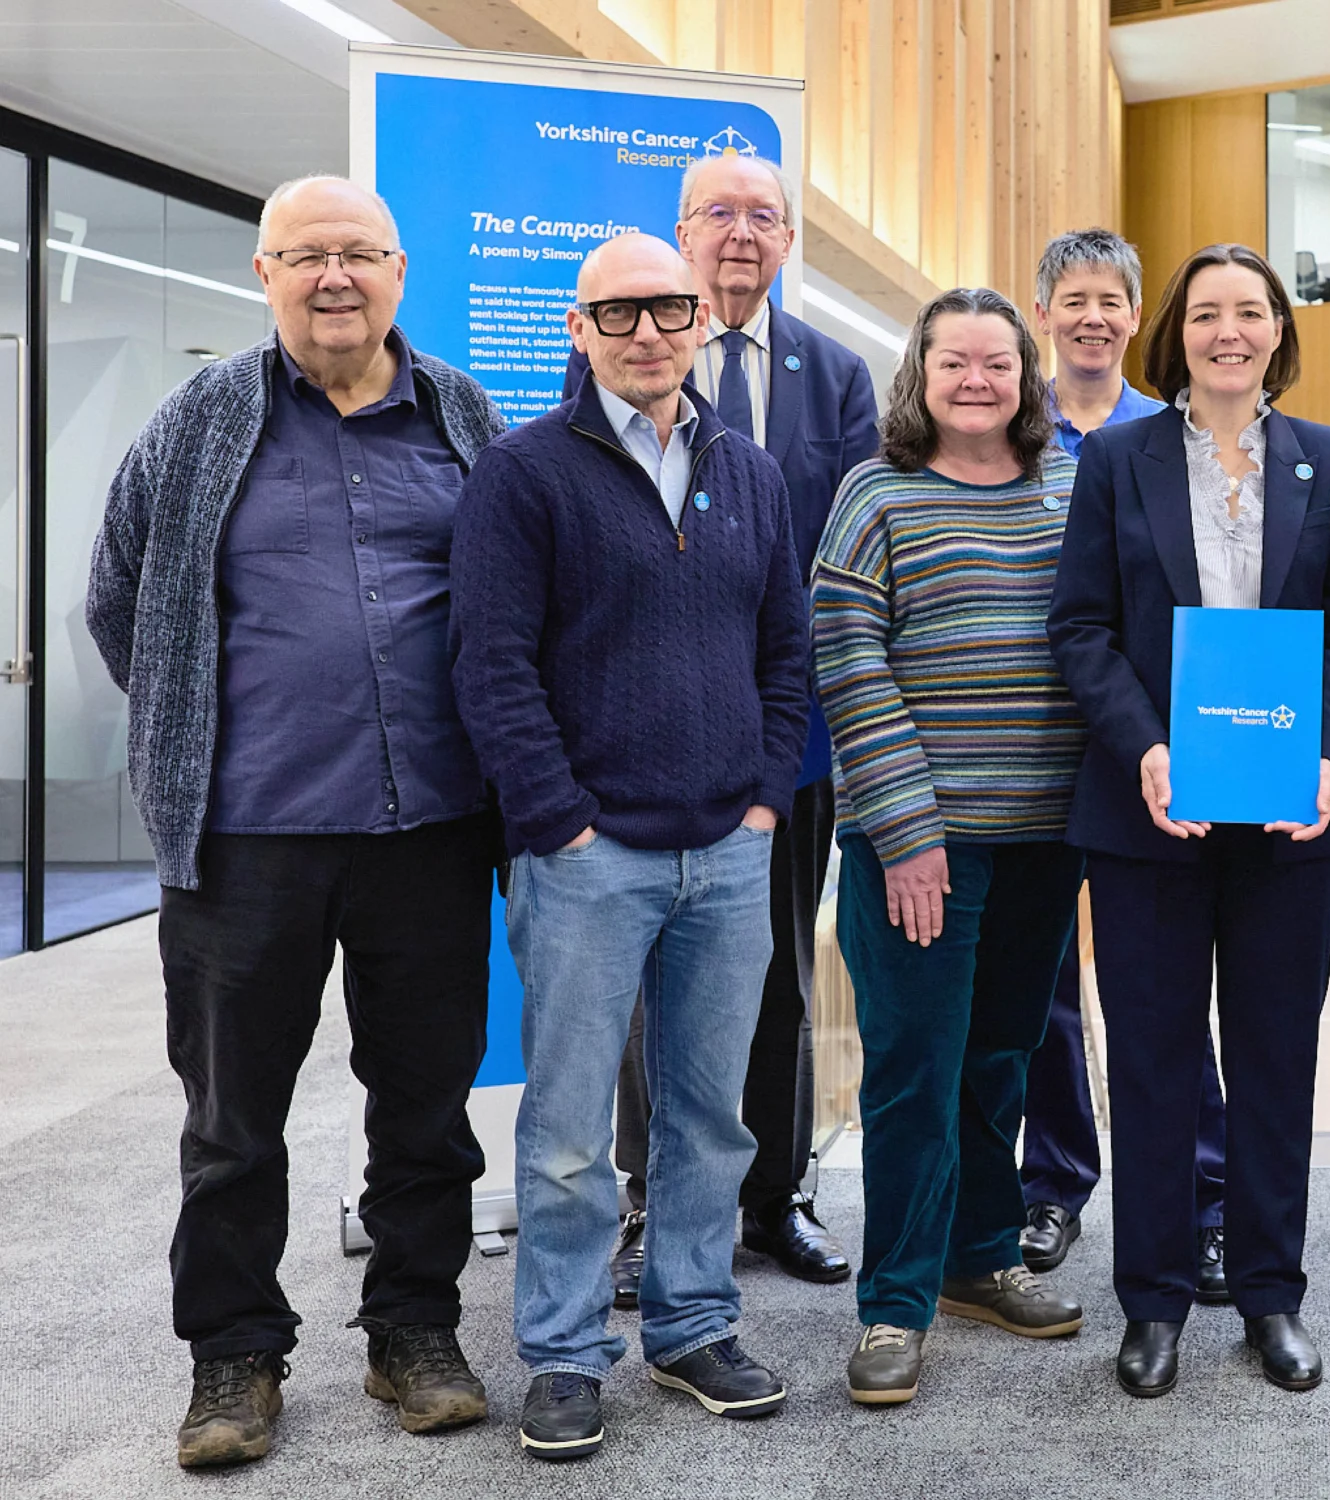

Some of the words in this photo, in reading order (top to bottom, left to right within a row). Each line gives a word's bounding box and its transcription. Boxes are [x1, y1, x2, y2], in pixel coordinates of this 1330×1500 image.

[535, 121, 629, 145] Yorkshire
[632, 129, 699, 149] Cancer
[616, 147, 697, 169] Research
[470, 211, 516, 234] The
[54, 209, 88, 304] 7
[469, 243, 481, 256] A
[482, 246, 520, 259] poem
[522, 247, 540, 262] by
[542, 247, 584, 261] Simon
[469, 283, 508, 294] Because
[508, 286, 521, 295] we
[523, 285, 565, 298] famously
[469, 297, 483, 306] we
[484, 297, 503, 307] said
[505, 298, 520, 308] the
[521, 299, 545, 309] word
[469, 311, 493, 319] went
[494, 310, 528, 322] looking
[530, 311, 543, 320] for
[469, 322, 497, 332] When
[498, 323, 506, 332] it
[506, 323, 537, 334] reared
[537, 327, 550, 336] up
[551, 325, 560, 334] in
[469, 335, 520, 346] outflanked
[521, 337, 532, 347] it,
[533, 337, 565, 347] stoned
[469, 348, 497, 358] When
[498, 349, 506, 358] it
[506, 349, 521, 359] hid
[523, 350, 532, 359] in
[533, 350, 550, 360] the
[469, 361, 502, 371] chased
[503, 362, 512, 371] it
[512, 362, 531, 372] into
[532, 363, 549, 372] the
[549, 365, 567, 375] ope
[517, 389, 525, 398] it
[526, 389, 554, 399] raised
[503, 402, 519, 411] the
[520, 403, 546, 411] mush
[1197, 705, 1239, 716] Yorkshire
[1238, 707, 1270, 717] Cancer
[1231, 715, 1269, 726] Research
